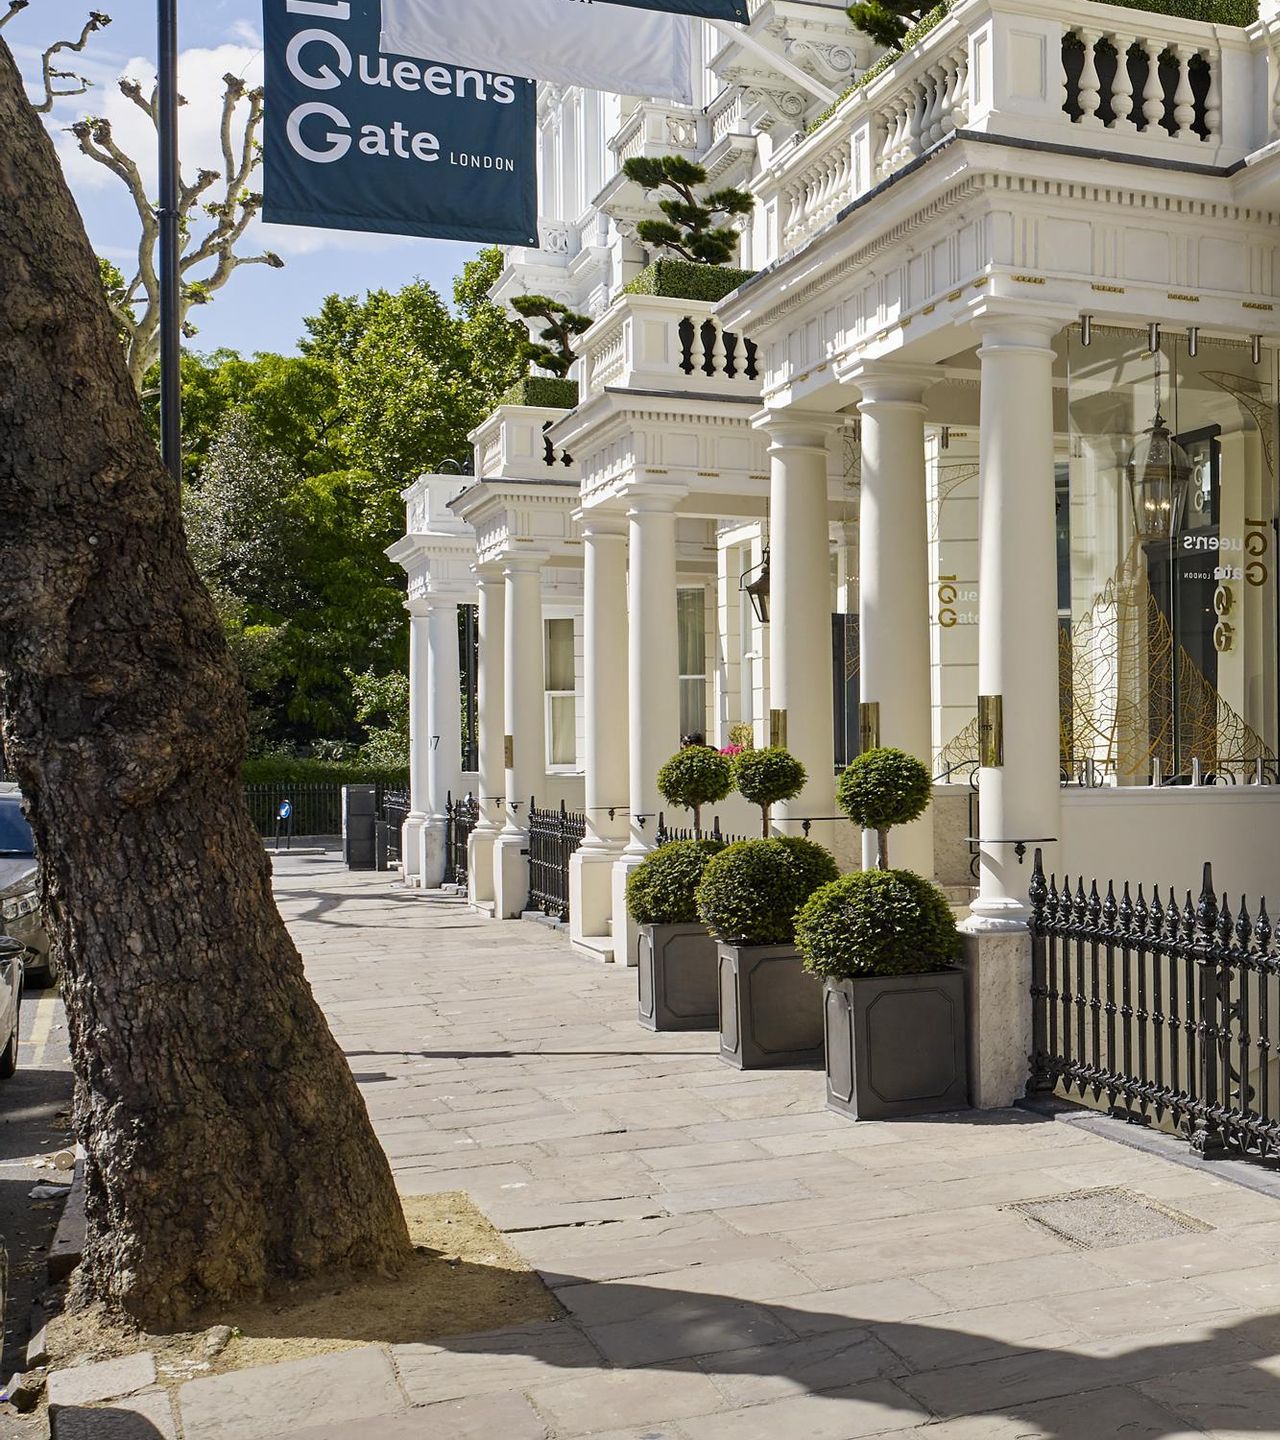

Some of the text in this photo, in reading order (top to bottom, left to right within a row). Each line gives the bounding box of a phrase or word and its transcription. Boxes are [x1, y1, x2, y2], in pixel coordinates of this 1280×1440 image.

[286, 28, 515, 104] Queen's
[286, 101, 514, 172] Gate LONDON
